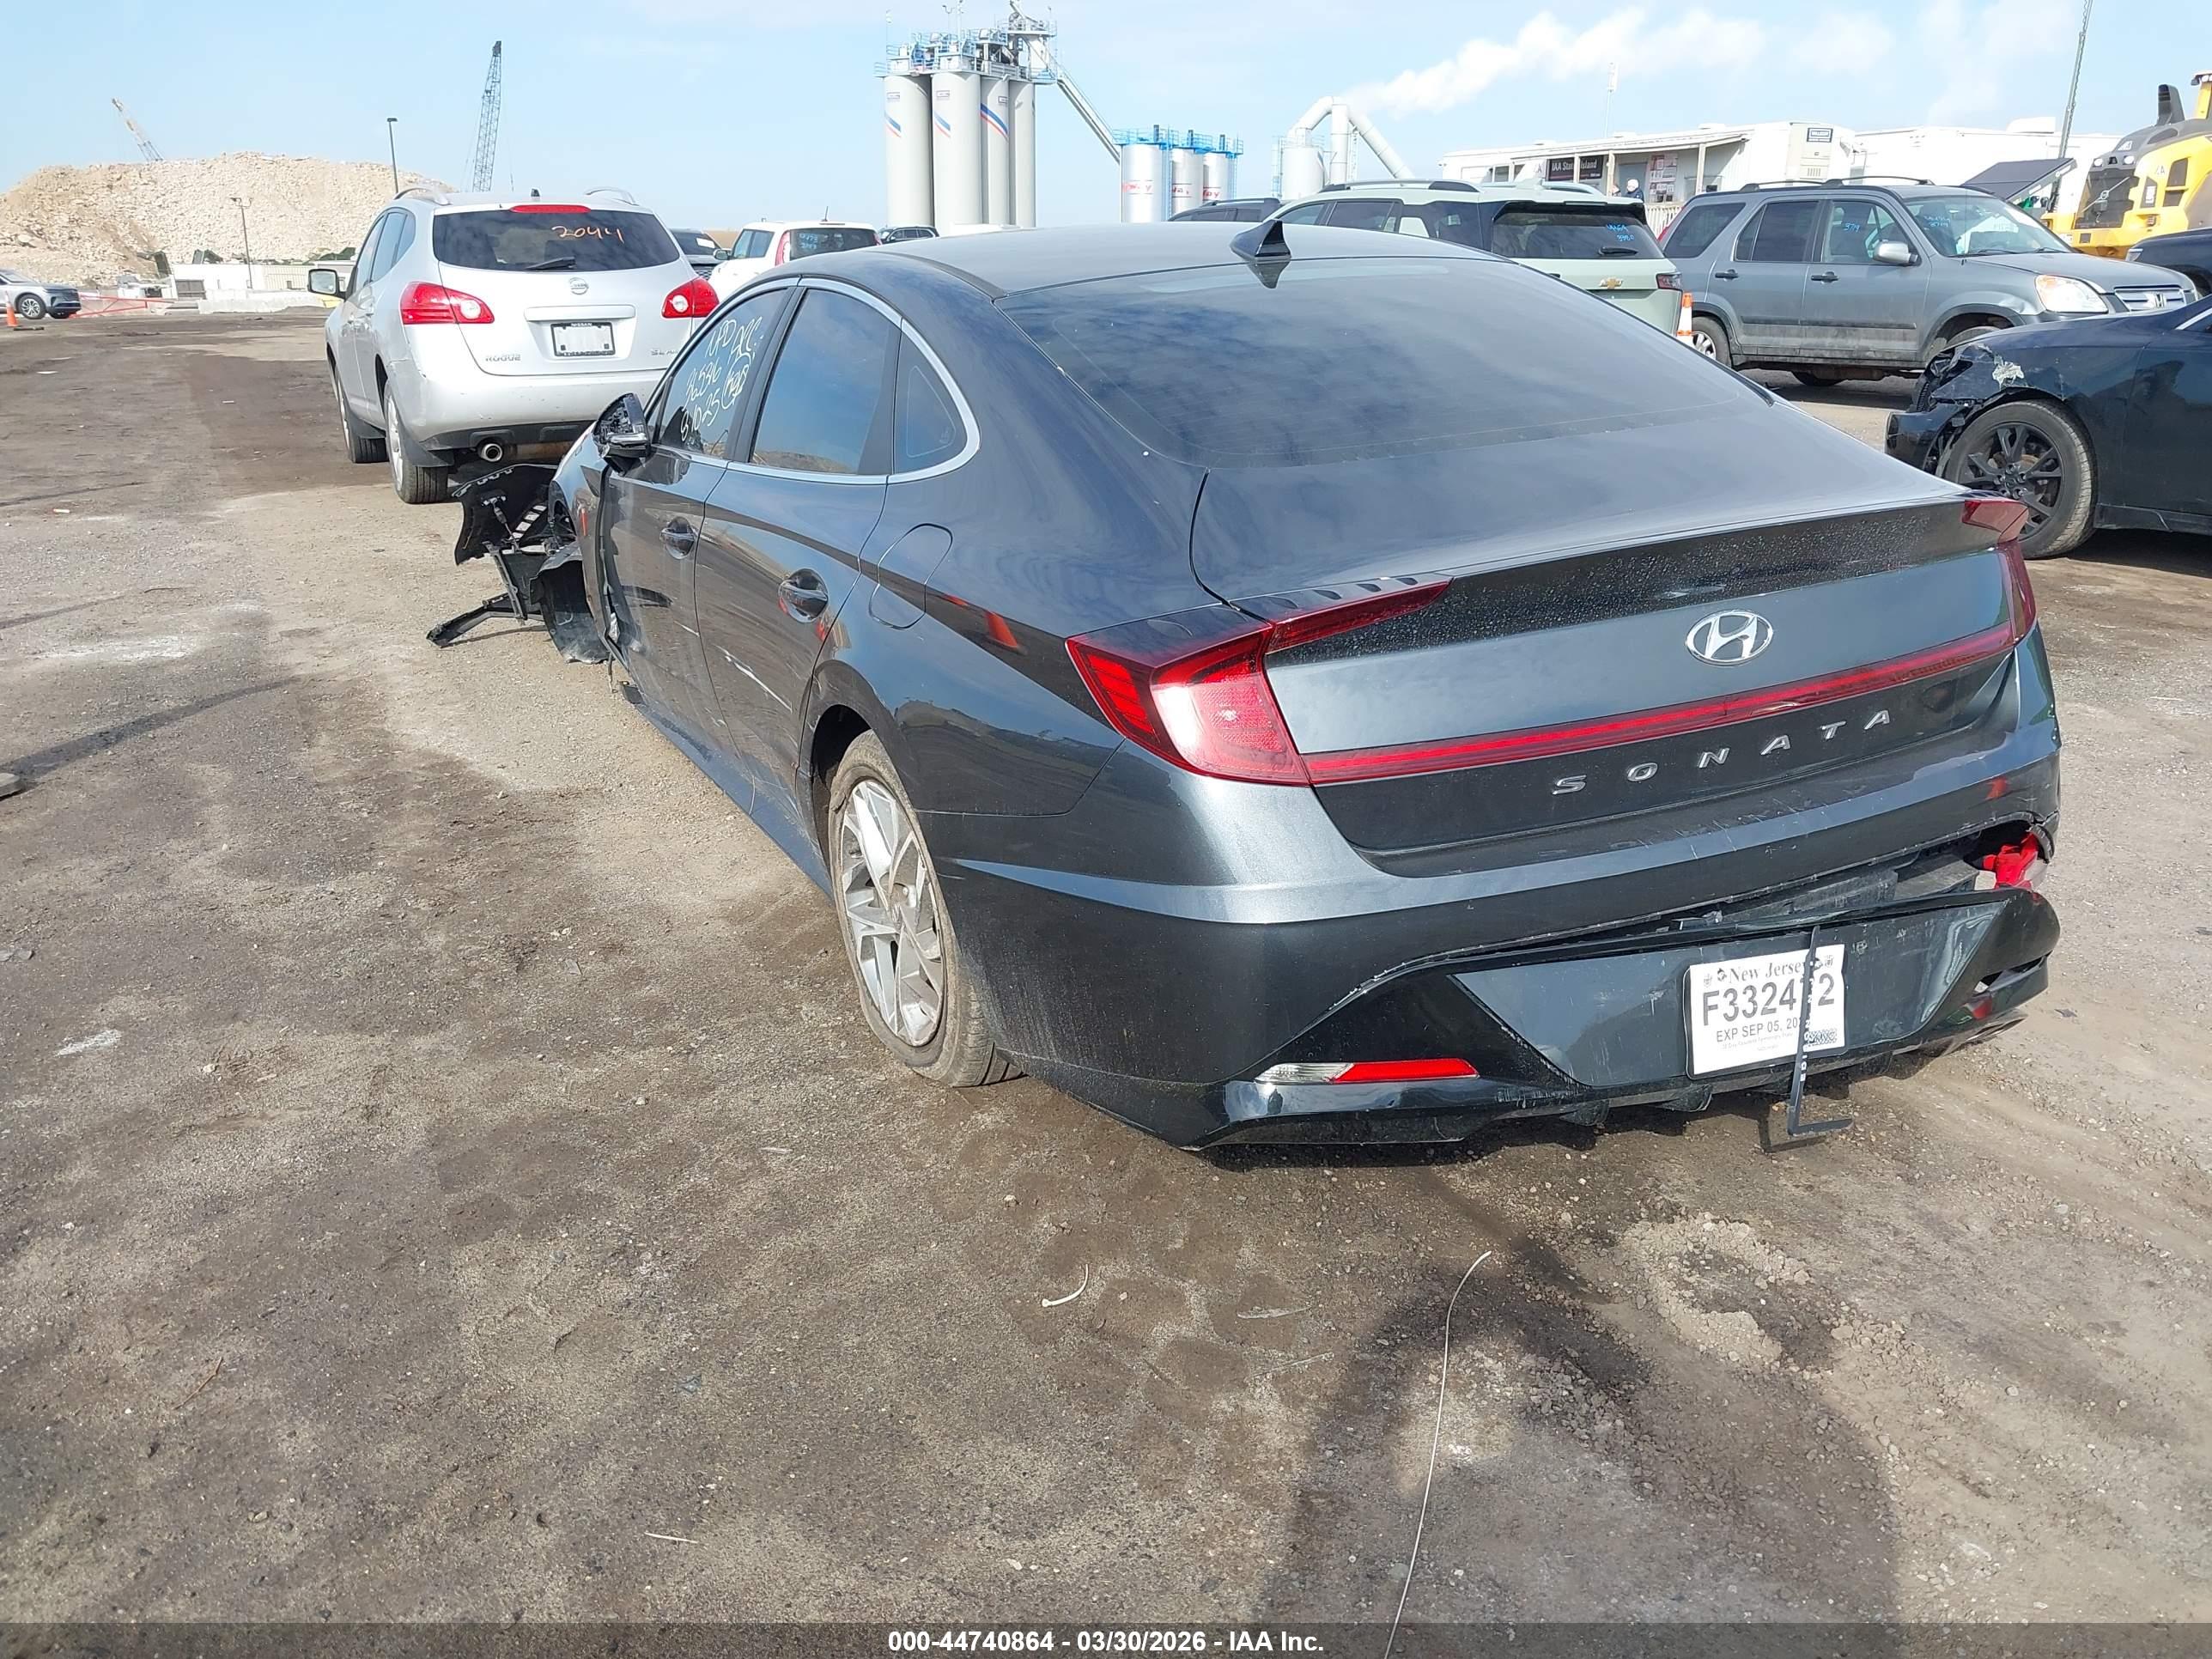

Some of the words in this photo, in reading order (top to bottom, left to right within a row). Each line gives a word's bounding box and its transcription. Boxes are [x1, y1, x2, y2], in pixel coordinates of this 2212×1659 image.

[1552, 708, 1891, 796] SONATA
[1729, 965, 1759, 983] New
[1703, 972, 1835, 1026] F33242
[1716, 1029, 1738, 1042] EXP
[1741, 1024, 1764, 1038] SEP
